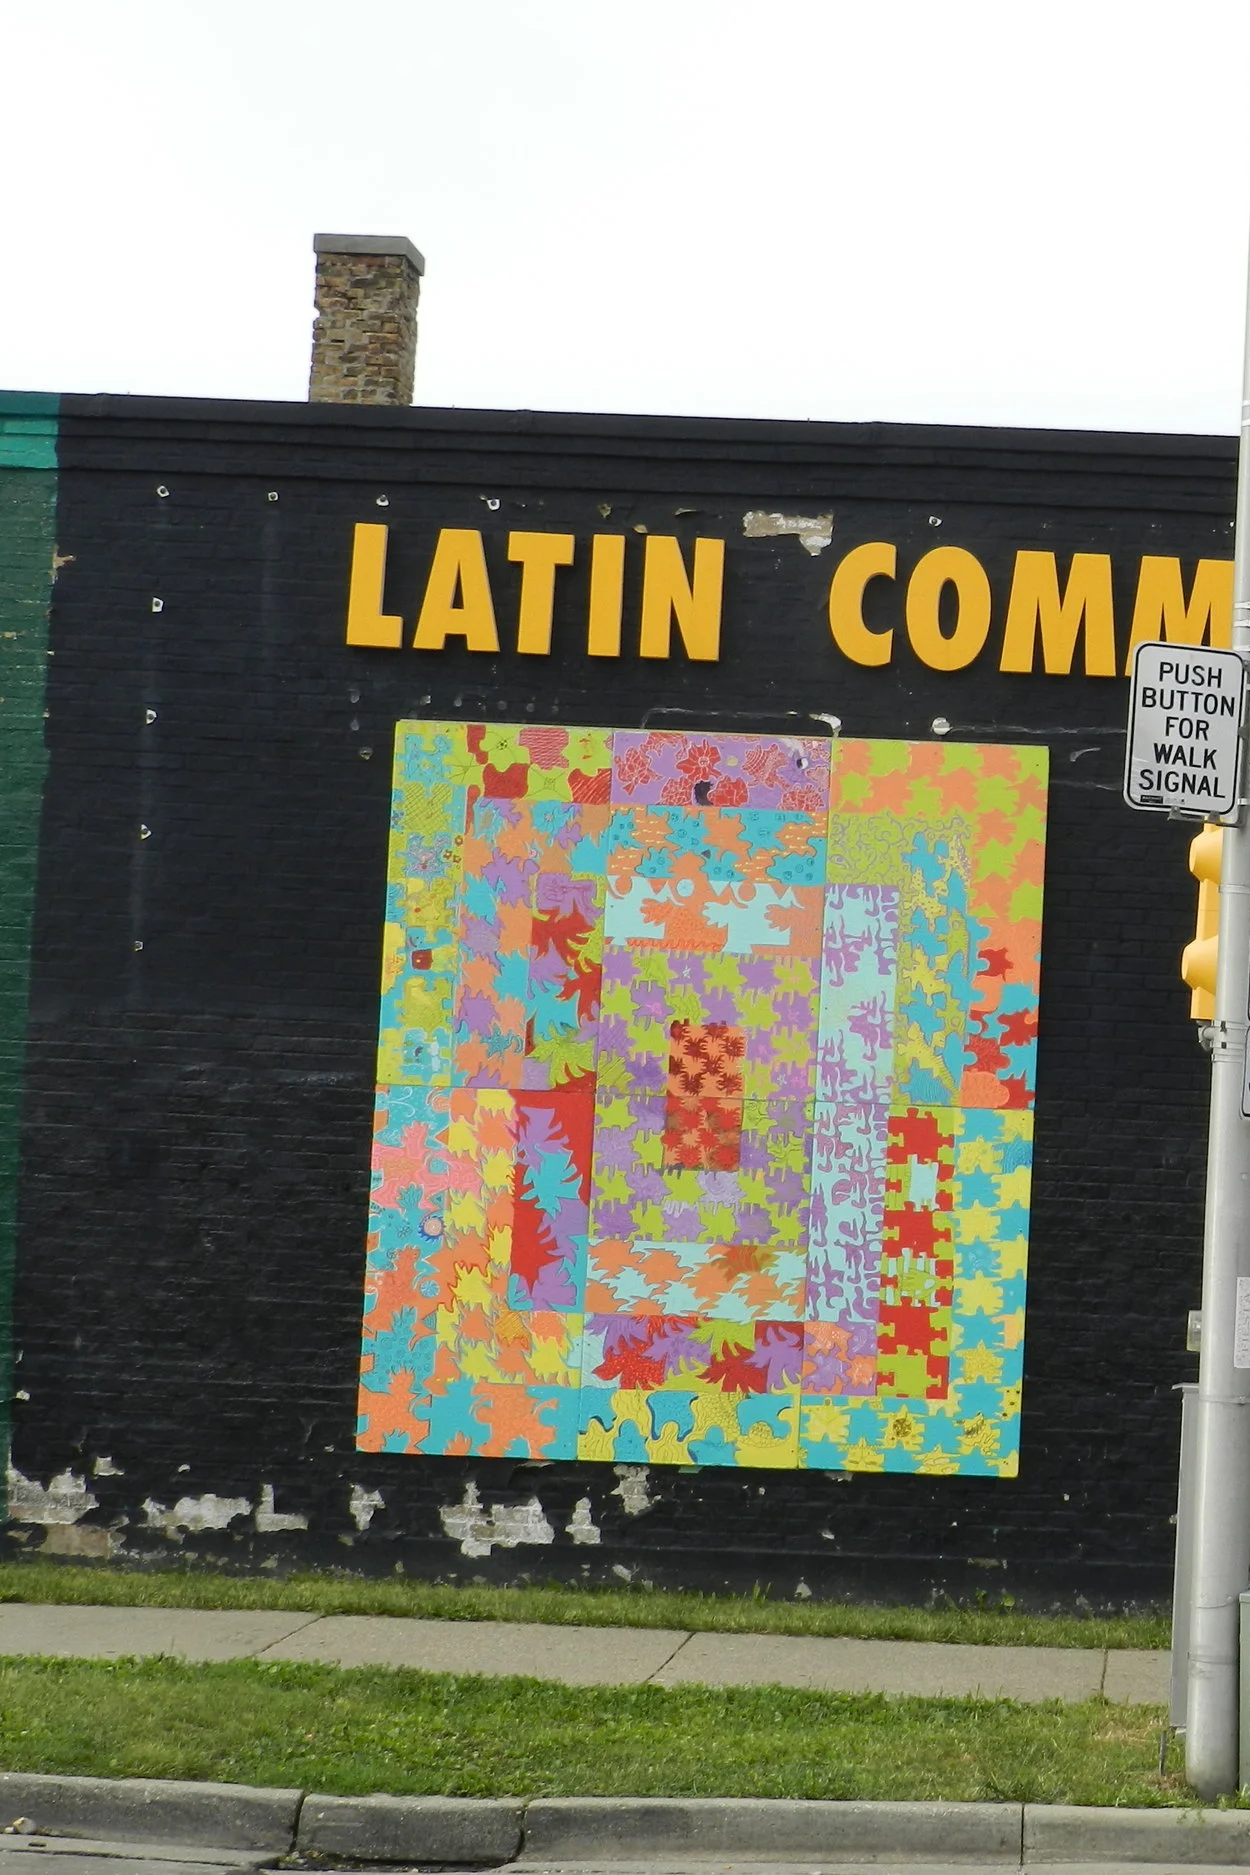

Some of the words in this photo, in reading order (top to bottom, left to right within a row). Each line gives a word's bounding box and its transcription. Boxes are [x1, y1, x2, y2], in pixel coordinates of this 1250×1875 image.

[346, 523, 725, 662] LATIN
[1159, 661, 1222, 689] PUSH
[1142, 687, 1235, 717] BUTTON
[1165, 716, 1209, 741] FOR
[1153, 742, 1218, 770] WALK
[1138, 769, 1226, 799] SIGNAL
